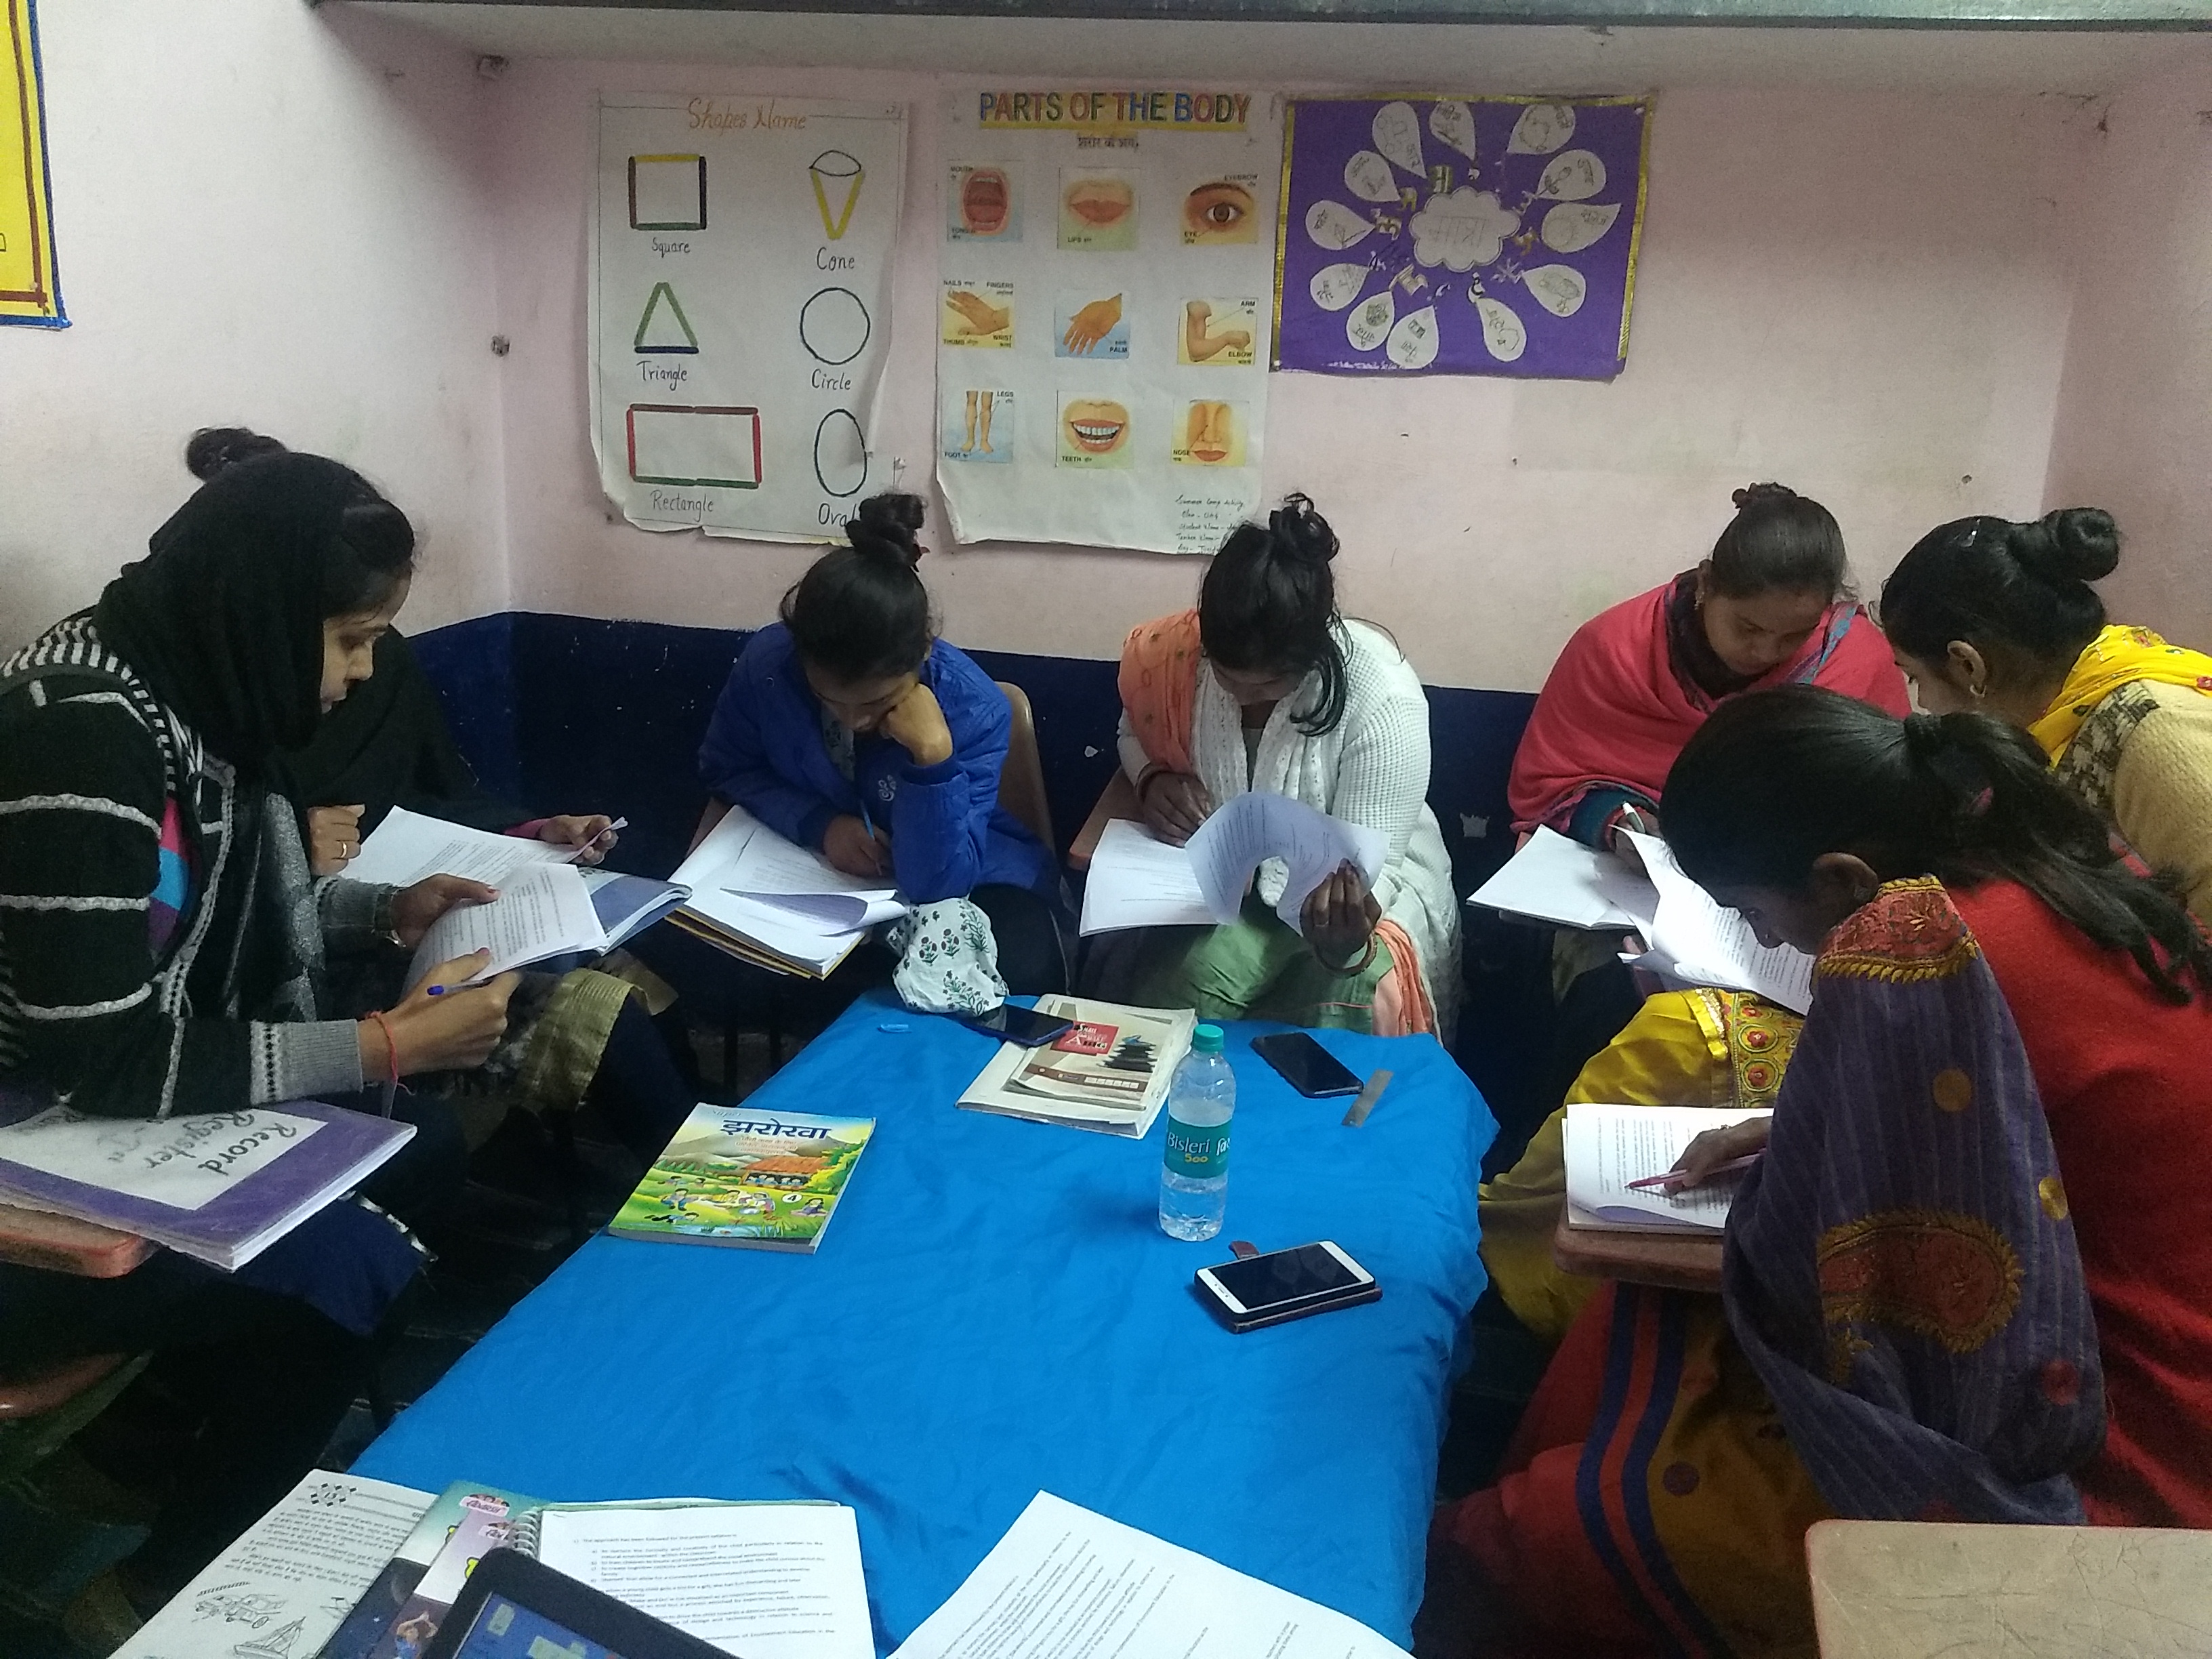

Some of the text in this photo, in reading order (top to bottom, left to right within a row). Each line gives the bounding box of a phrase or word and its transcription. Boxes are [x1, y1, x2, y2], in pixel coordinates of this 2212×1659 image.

[980, 92, 1252, 124] PARTS OF THE BODY
[652, 237, 690, 258] Square
[817, 247, 855, 270] Cone
[636, 361, 687, 391] Triangle
[812, 369, 851, 391] Circle
[651, 490, 714, 521] Rectangle
[720, 1118, 832, 1139] झरोखा
[198, 1122, 297, 1176] Record
[1168, 1132, 1210, 1153] Bisleri
[1185, 1153, 1208, 1163] 500
